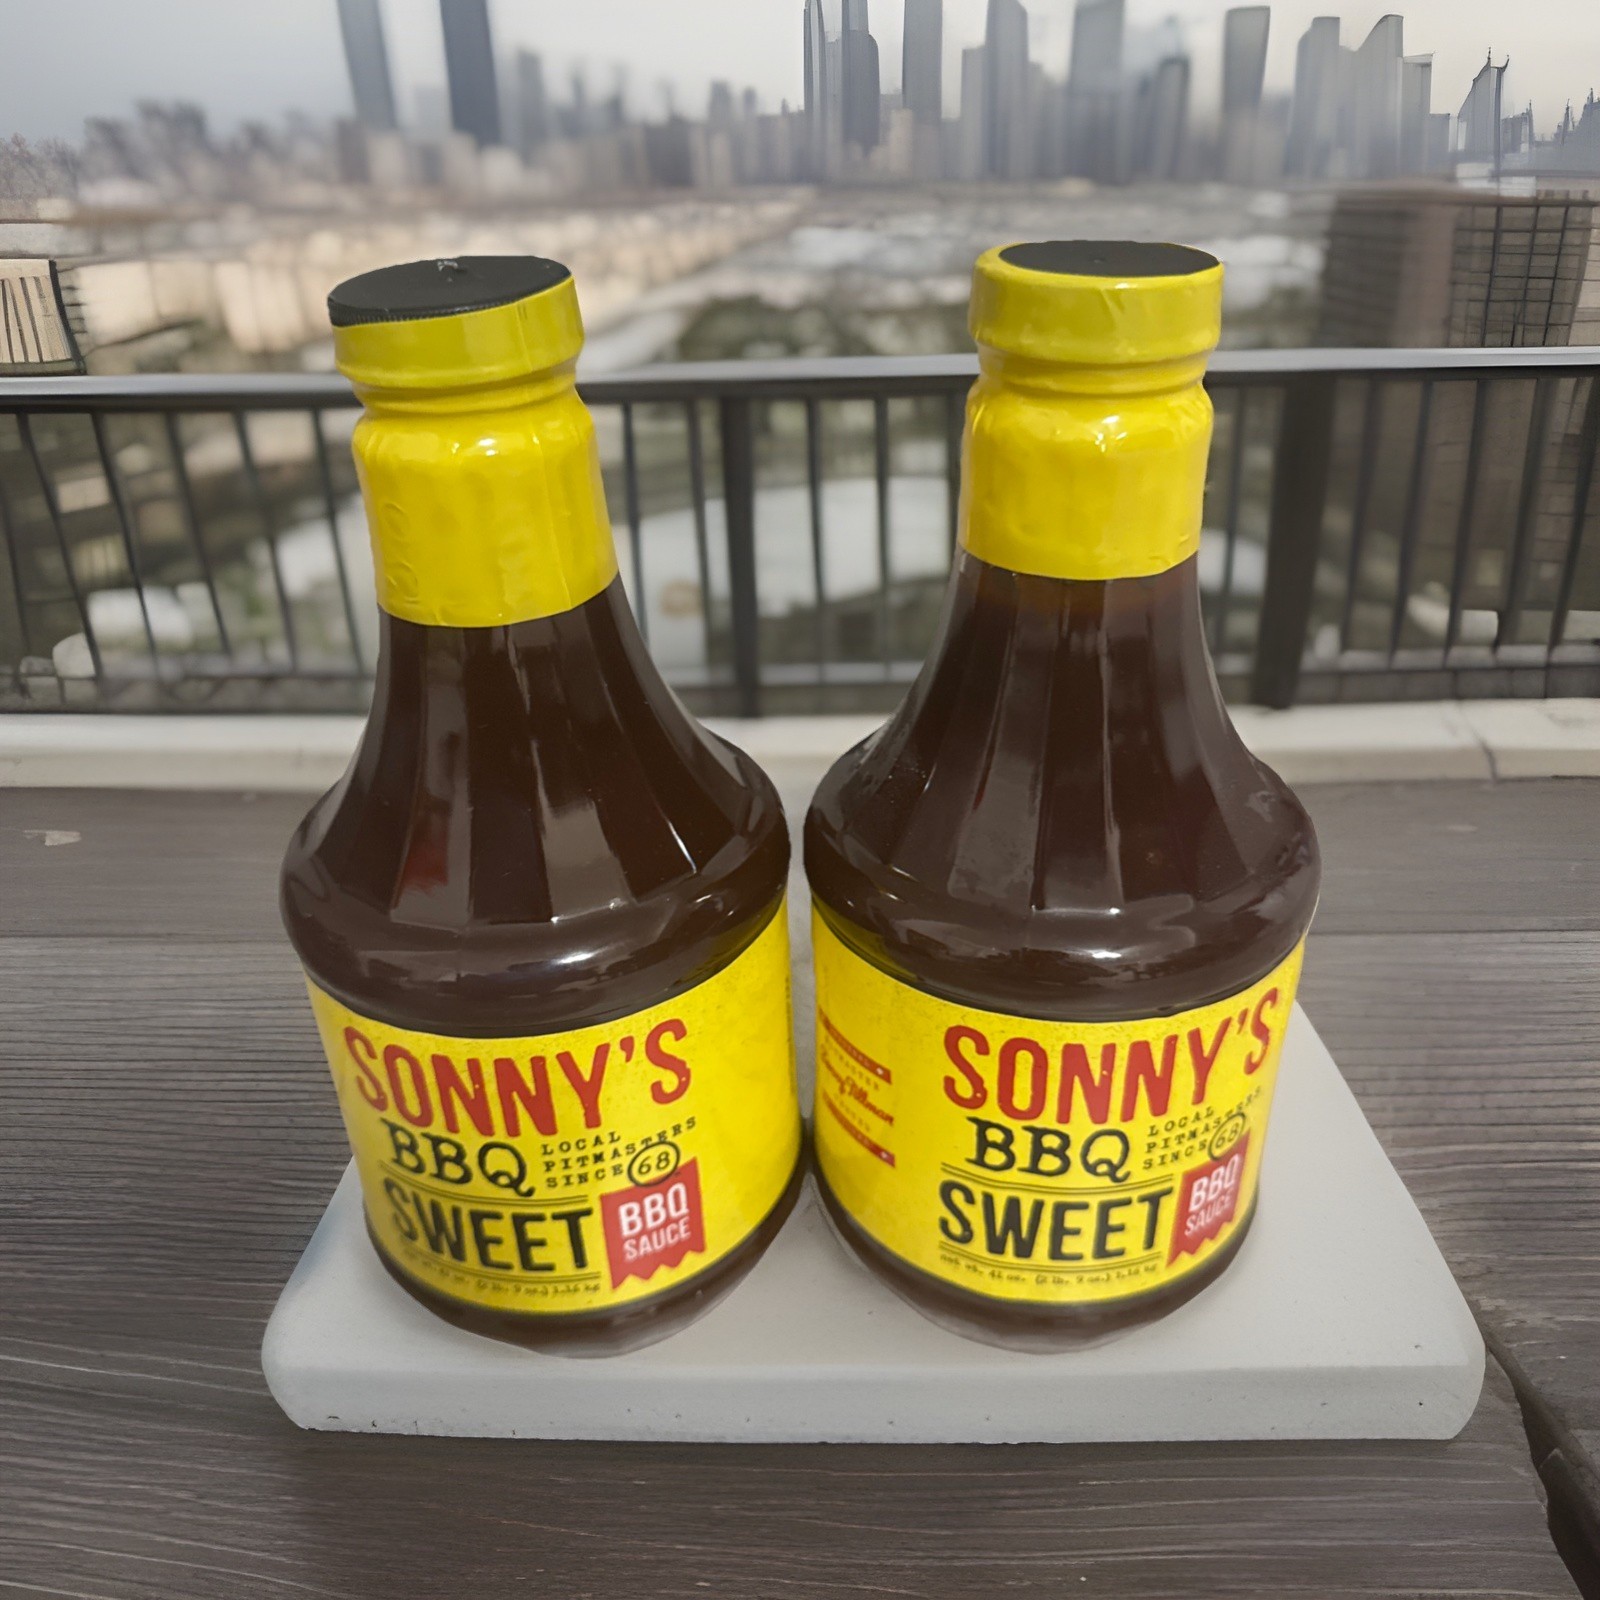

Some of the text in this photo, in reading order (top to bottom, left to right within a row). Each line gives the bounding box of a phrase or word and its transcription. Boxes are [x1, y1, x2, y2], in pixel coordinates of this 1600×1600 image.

[343, 1018, 691, 1137] SONNY'S
[943, 987, 1278, 1125] SONNY'S
[542, 1131, 621, 1156] LOCAL
[544, 1116, 697, 1173] PITMASTERS
[1143, 1122, 1240, 1169] SINCE 68
[1145, 1085, 1262, 1154] PITMASTERS
[1148, 1106, 1215, 1137] LOCAL
[380, 1117, 535, 1197] BBQ
[546, 1150, 671, 1188] SINCE 68
[966, 1116, 1131, 1183] BBQ
[618, 1182, 690, 1238] BBQ
[1188, 1153, 1241, 1212] BBQ
[384, 1177, 593, 1272] SWEET
[623, 1216, 692, 1262] SAUCE
[939, 1180, 1174, 1262] SWEET
[1184, 1188, 1233, 1237] SAUCE
